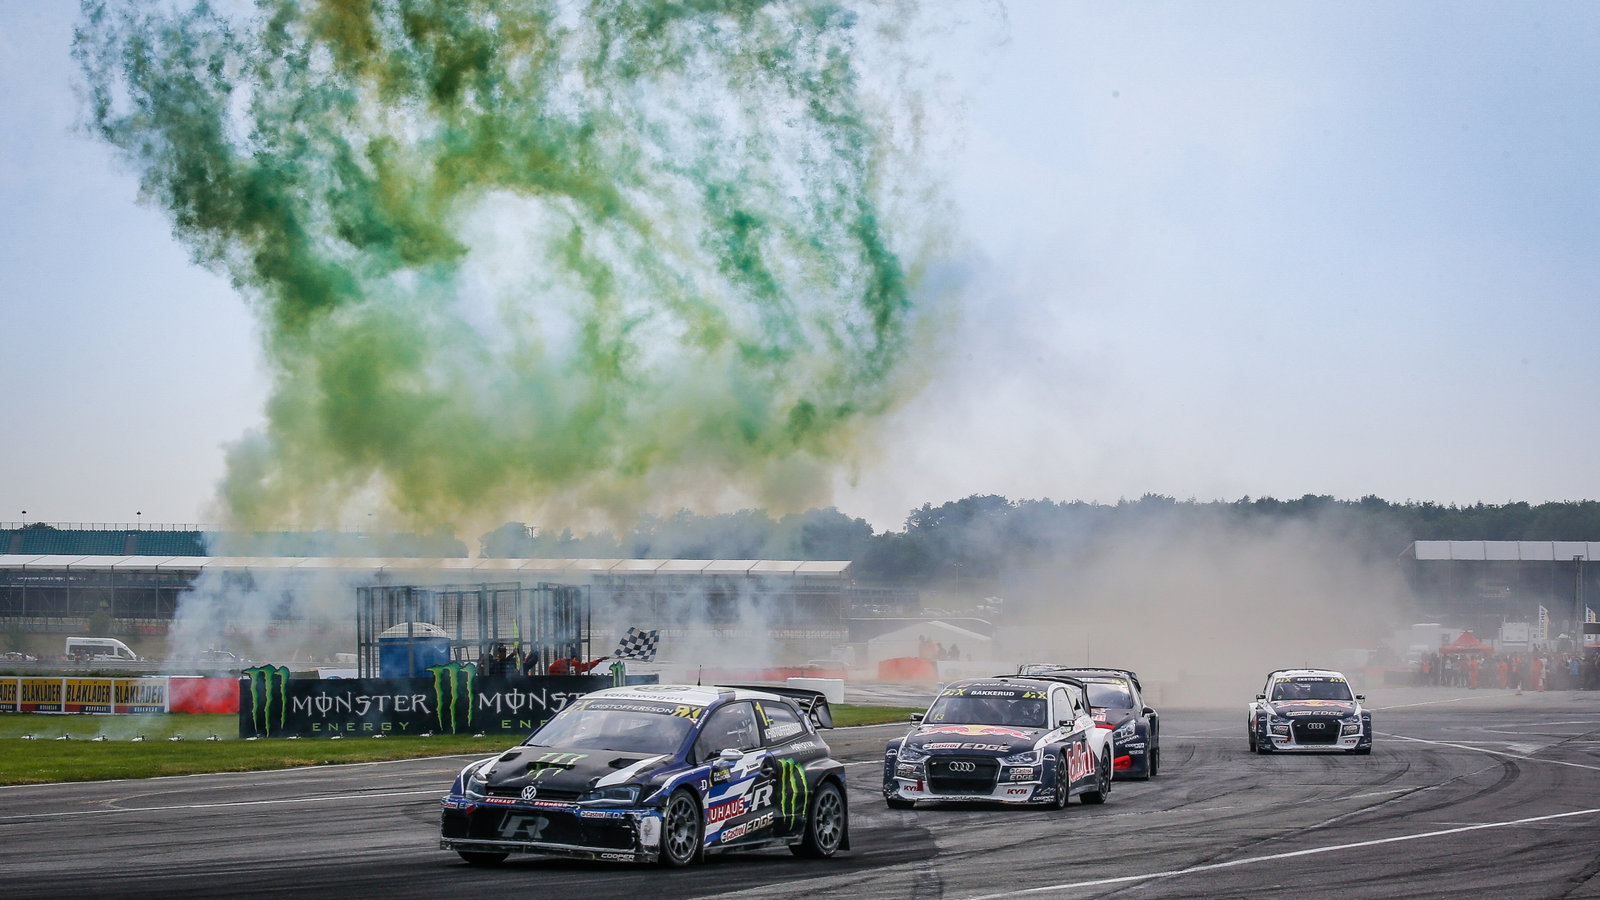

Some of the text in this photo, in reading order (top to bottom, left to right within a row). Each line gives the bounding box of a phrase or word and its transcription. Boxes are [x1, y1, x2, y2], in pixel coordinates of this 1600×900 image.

[67, 681, 111, 702] BLÅKLÄDER
[115, 681, 164, 703] BLÅKLÄDER
[292, 691, 432, 717] MONSTER
[588, 703, 674, 714] KRISTOFFERSSON
[312, 721, 410, 732] ENERGY
[931, 742, 1011, 752] Castrol EDGE
[746, 812, 774, 832] EDGE
